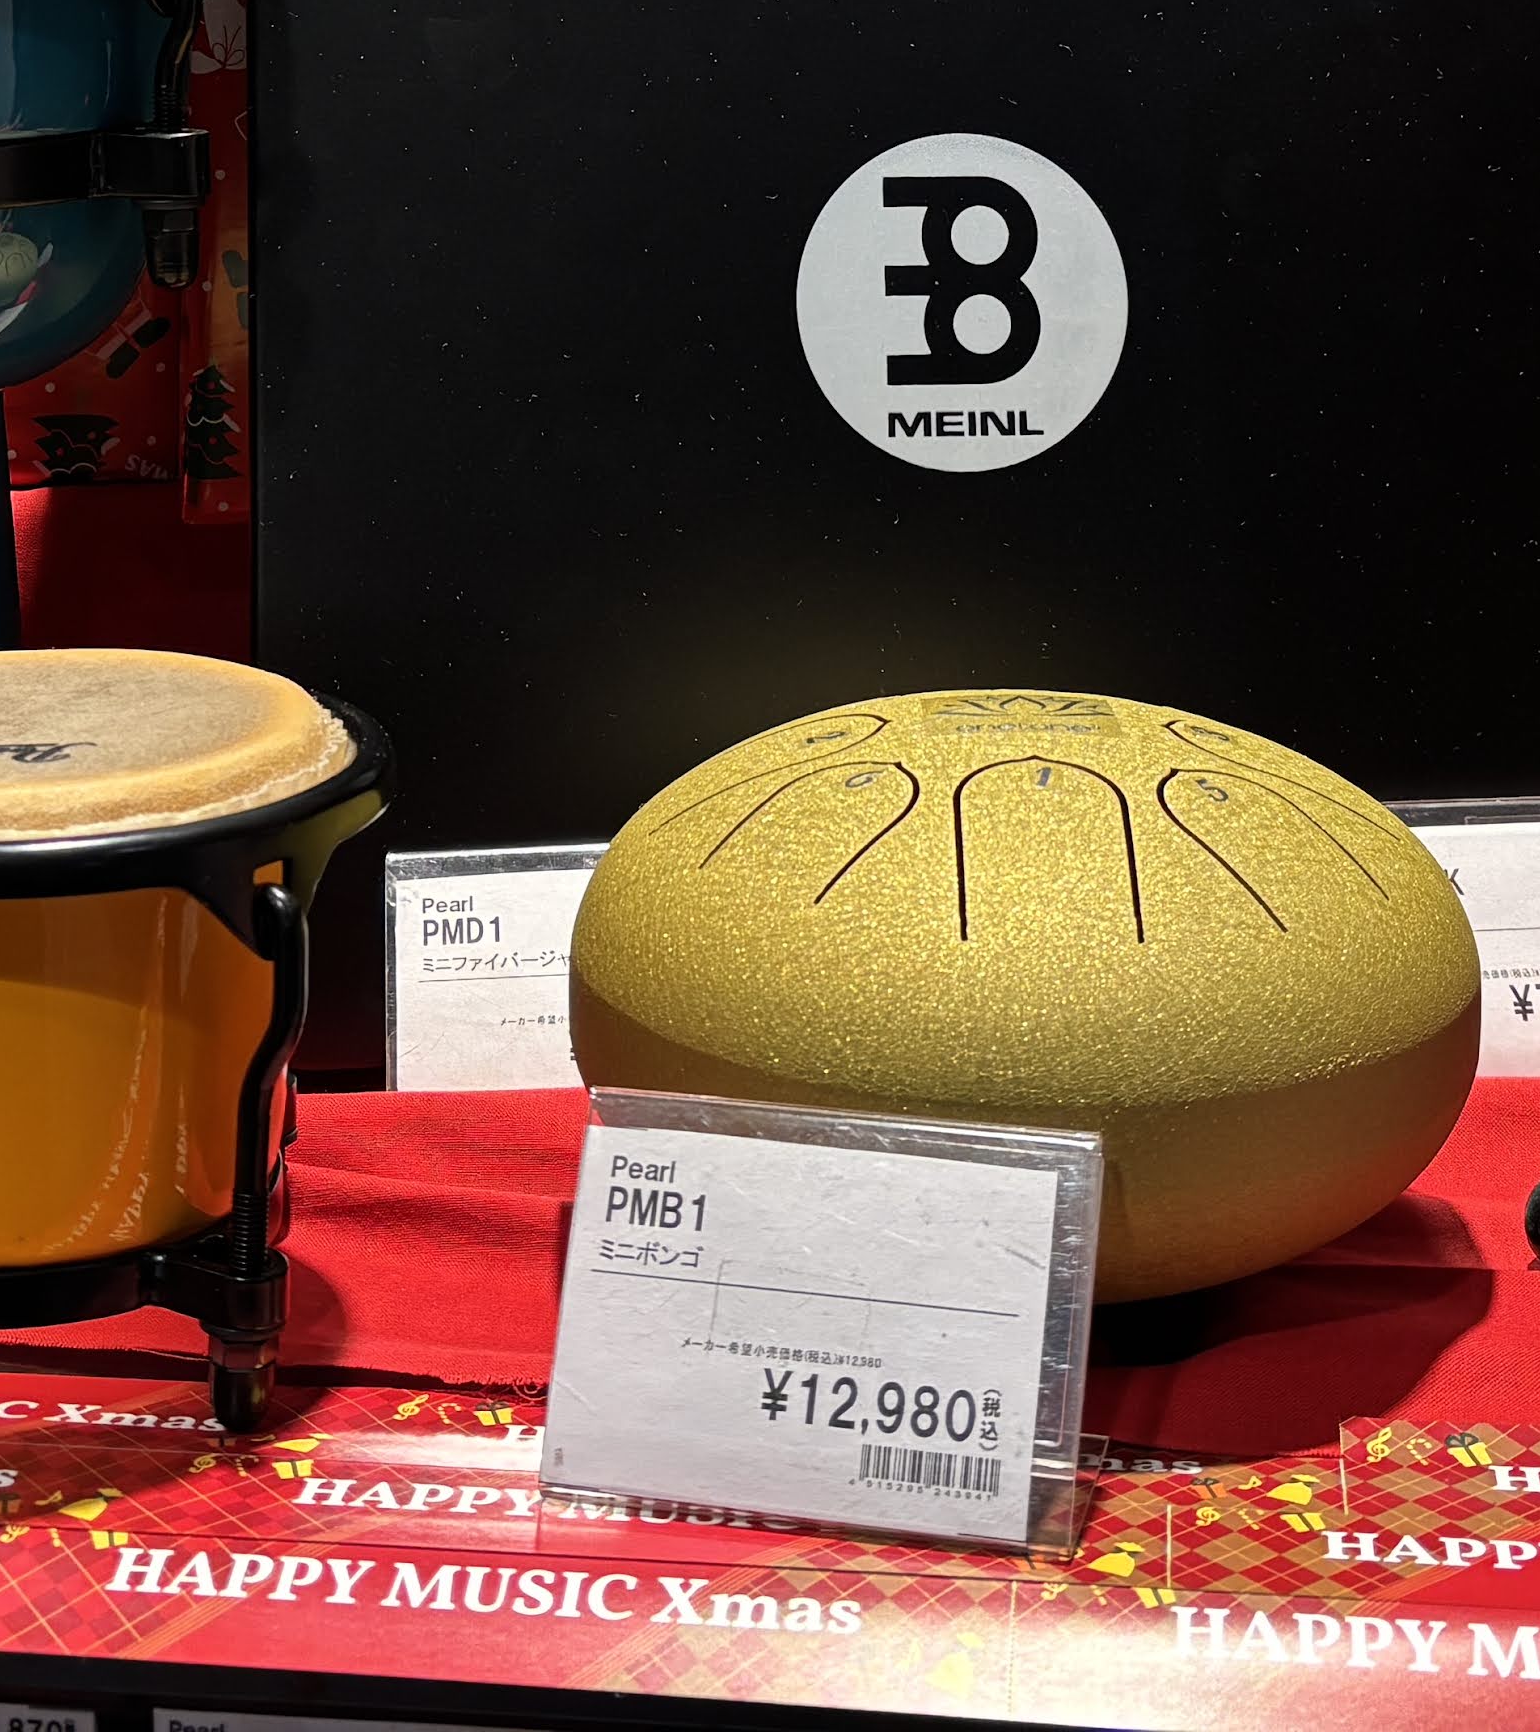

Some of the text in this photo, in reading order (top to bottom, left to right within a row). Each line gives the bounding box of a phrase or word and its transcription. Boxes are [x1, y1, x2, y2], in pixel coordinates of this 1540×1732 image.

[888, 411, 1044, 437] MEINL
[422, 896, 473, 913] Pearl
[423, 916, 500, 946] PMD1
[611, 1155, 676, 1183] Pearl
[605, 1186, 706, 1232] PMB1
[599, 1239, 704, 1268] ミニボンゴ
[43, 1403, 227, 1432] Xmas
[761, 1368, 1002, 1451] ¥12,980 (税込)
[290, 1477, 544, 1518] HAPPY
[105, 1547, 862, 1634] HAPPY MUSIC Xmas
[1169, 1606, 1447, 1673] HAPPY
